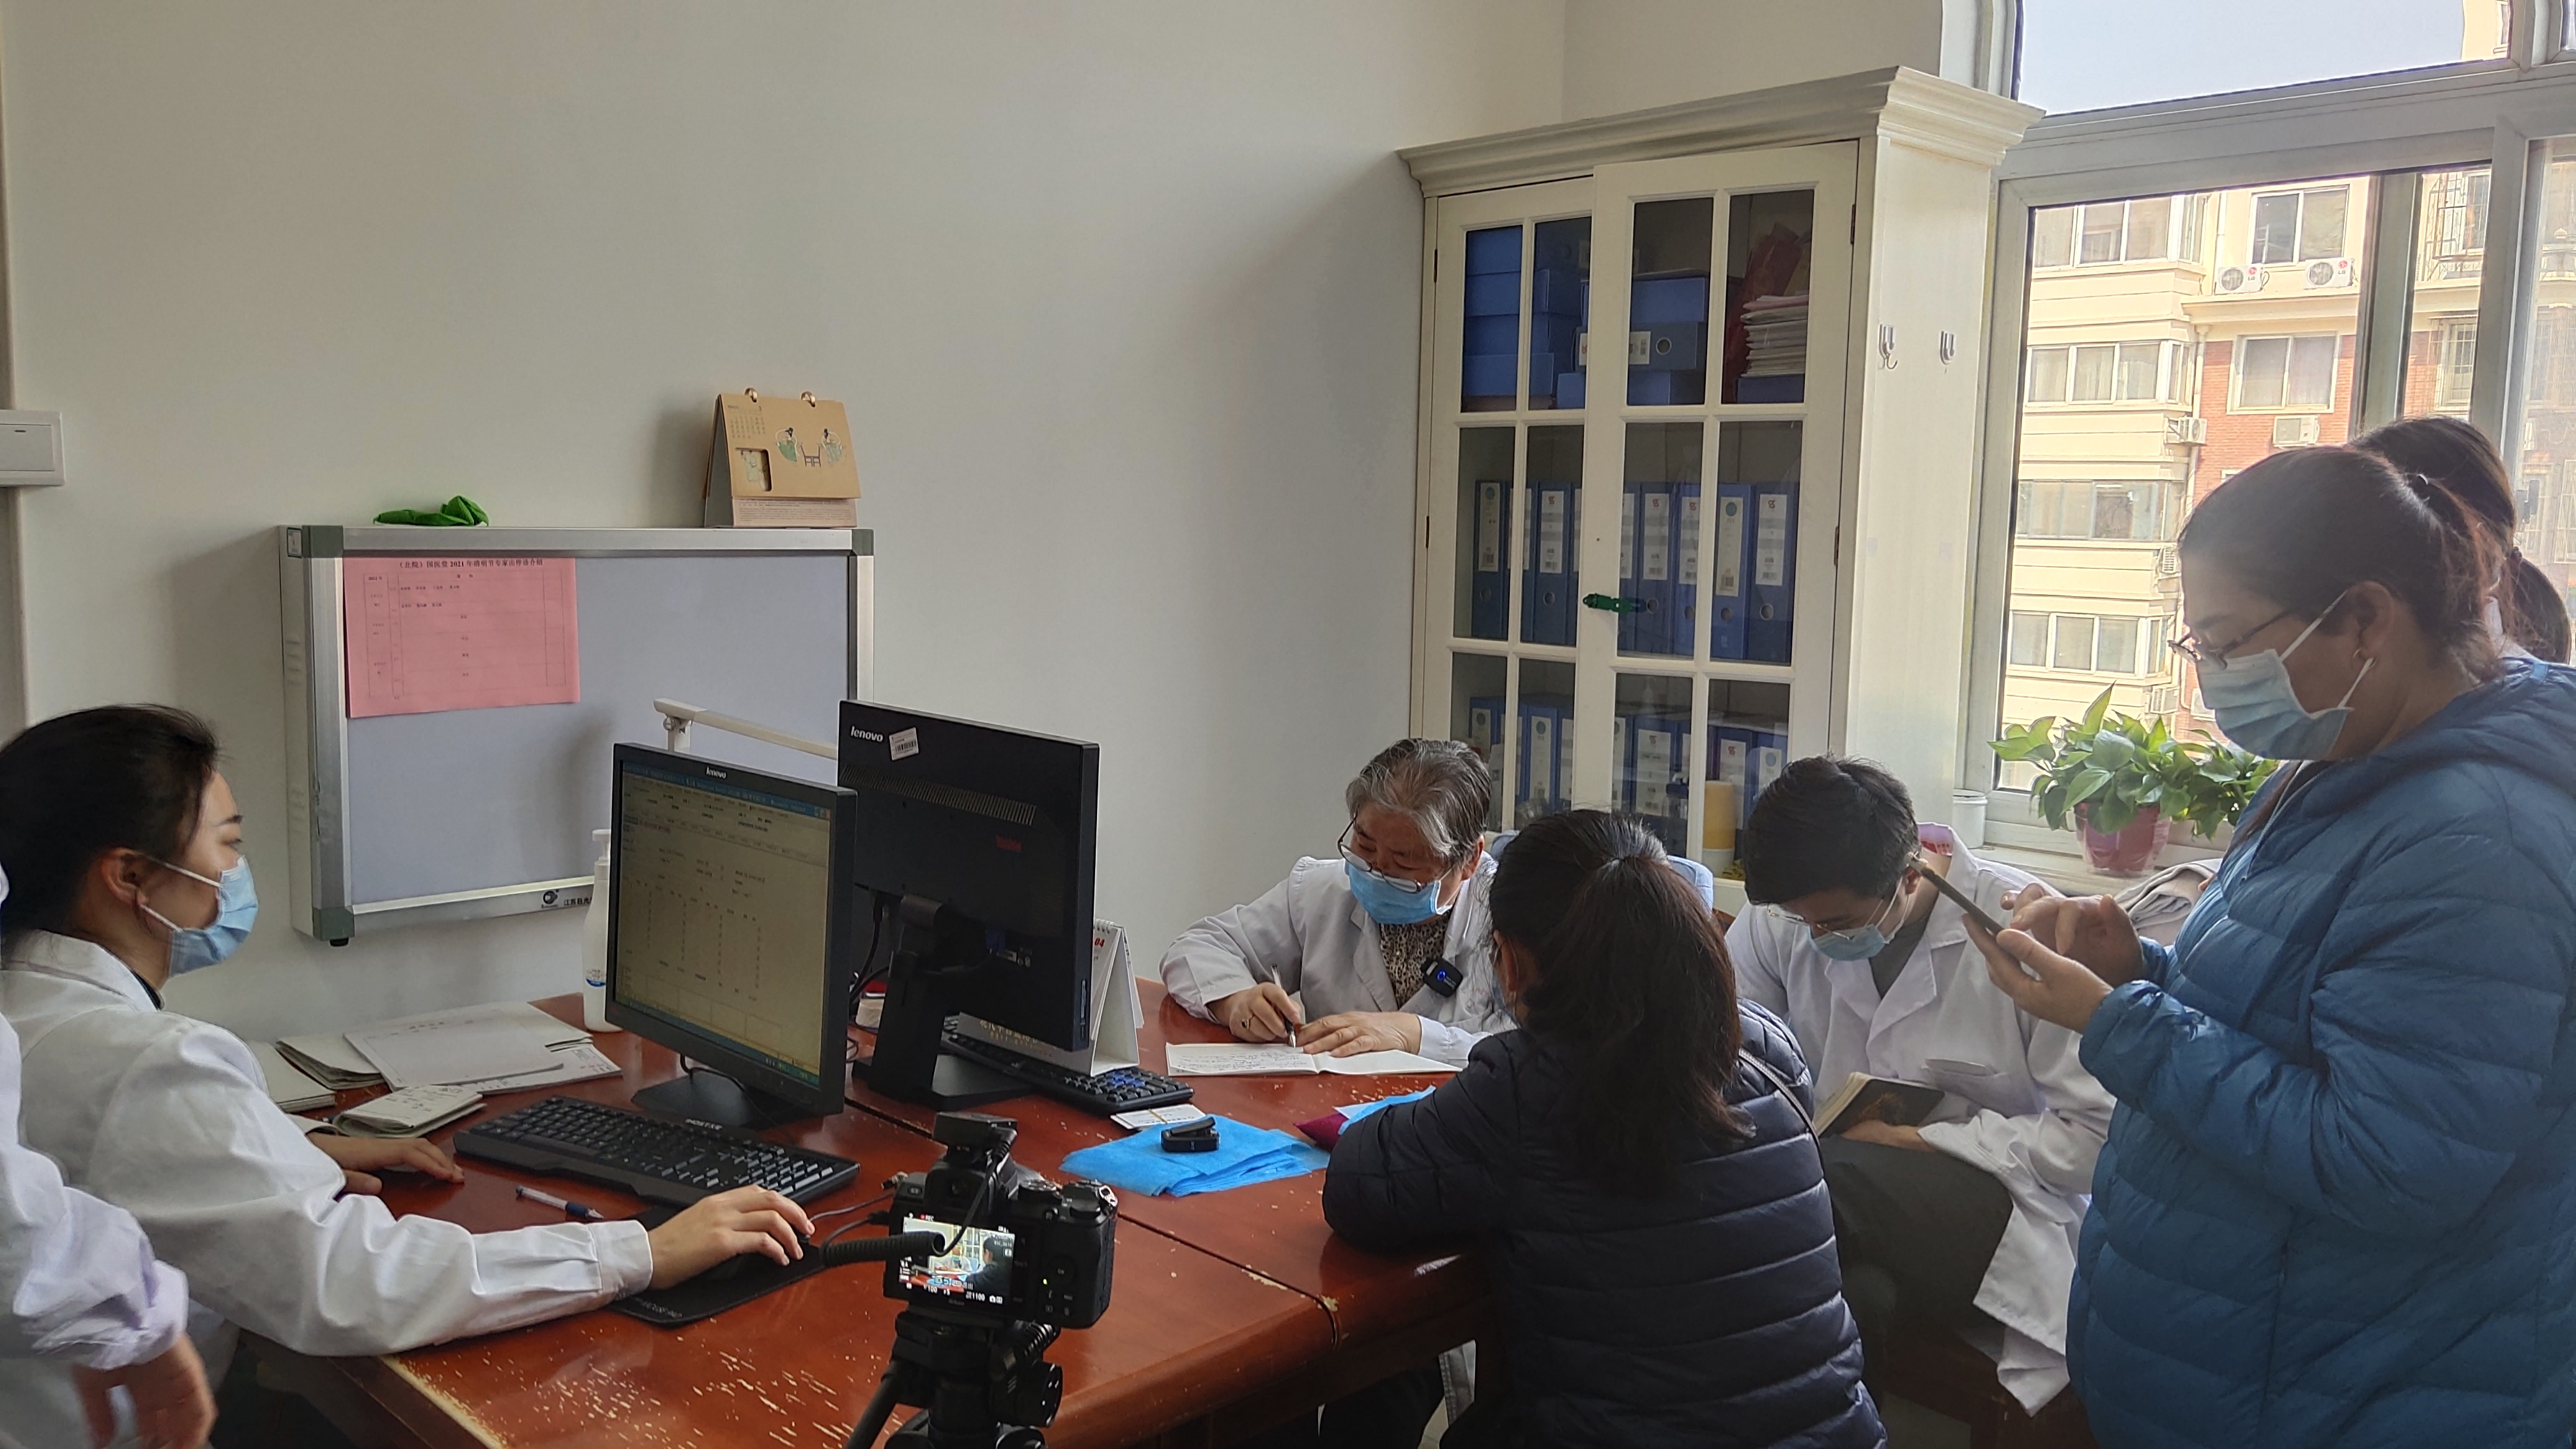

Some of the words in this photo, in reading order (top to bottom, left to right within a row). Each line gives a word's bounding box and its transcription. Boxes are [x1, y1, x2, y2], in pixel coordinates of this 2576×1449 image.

[850, 725, 884, 743] lenovo
[705, 766, 727, 779] lenovo
[1094, 937, 1105, 947] 04
